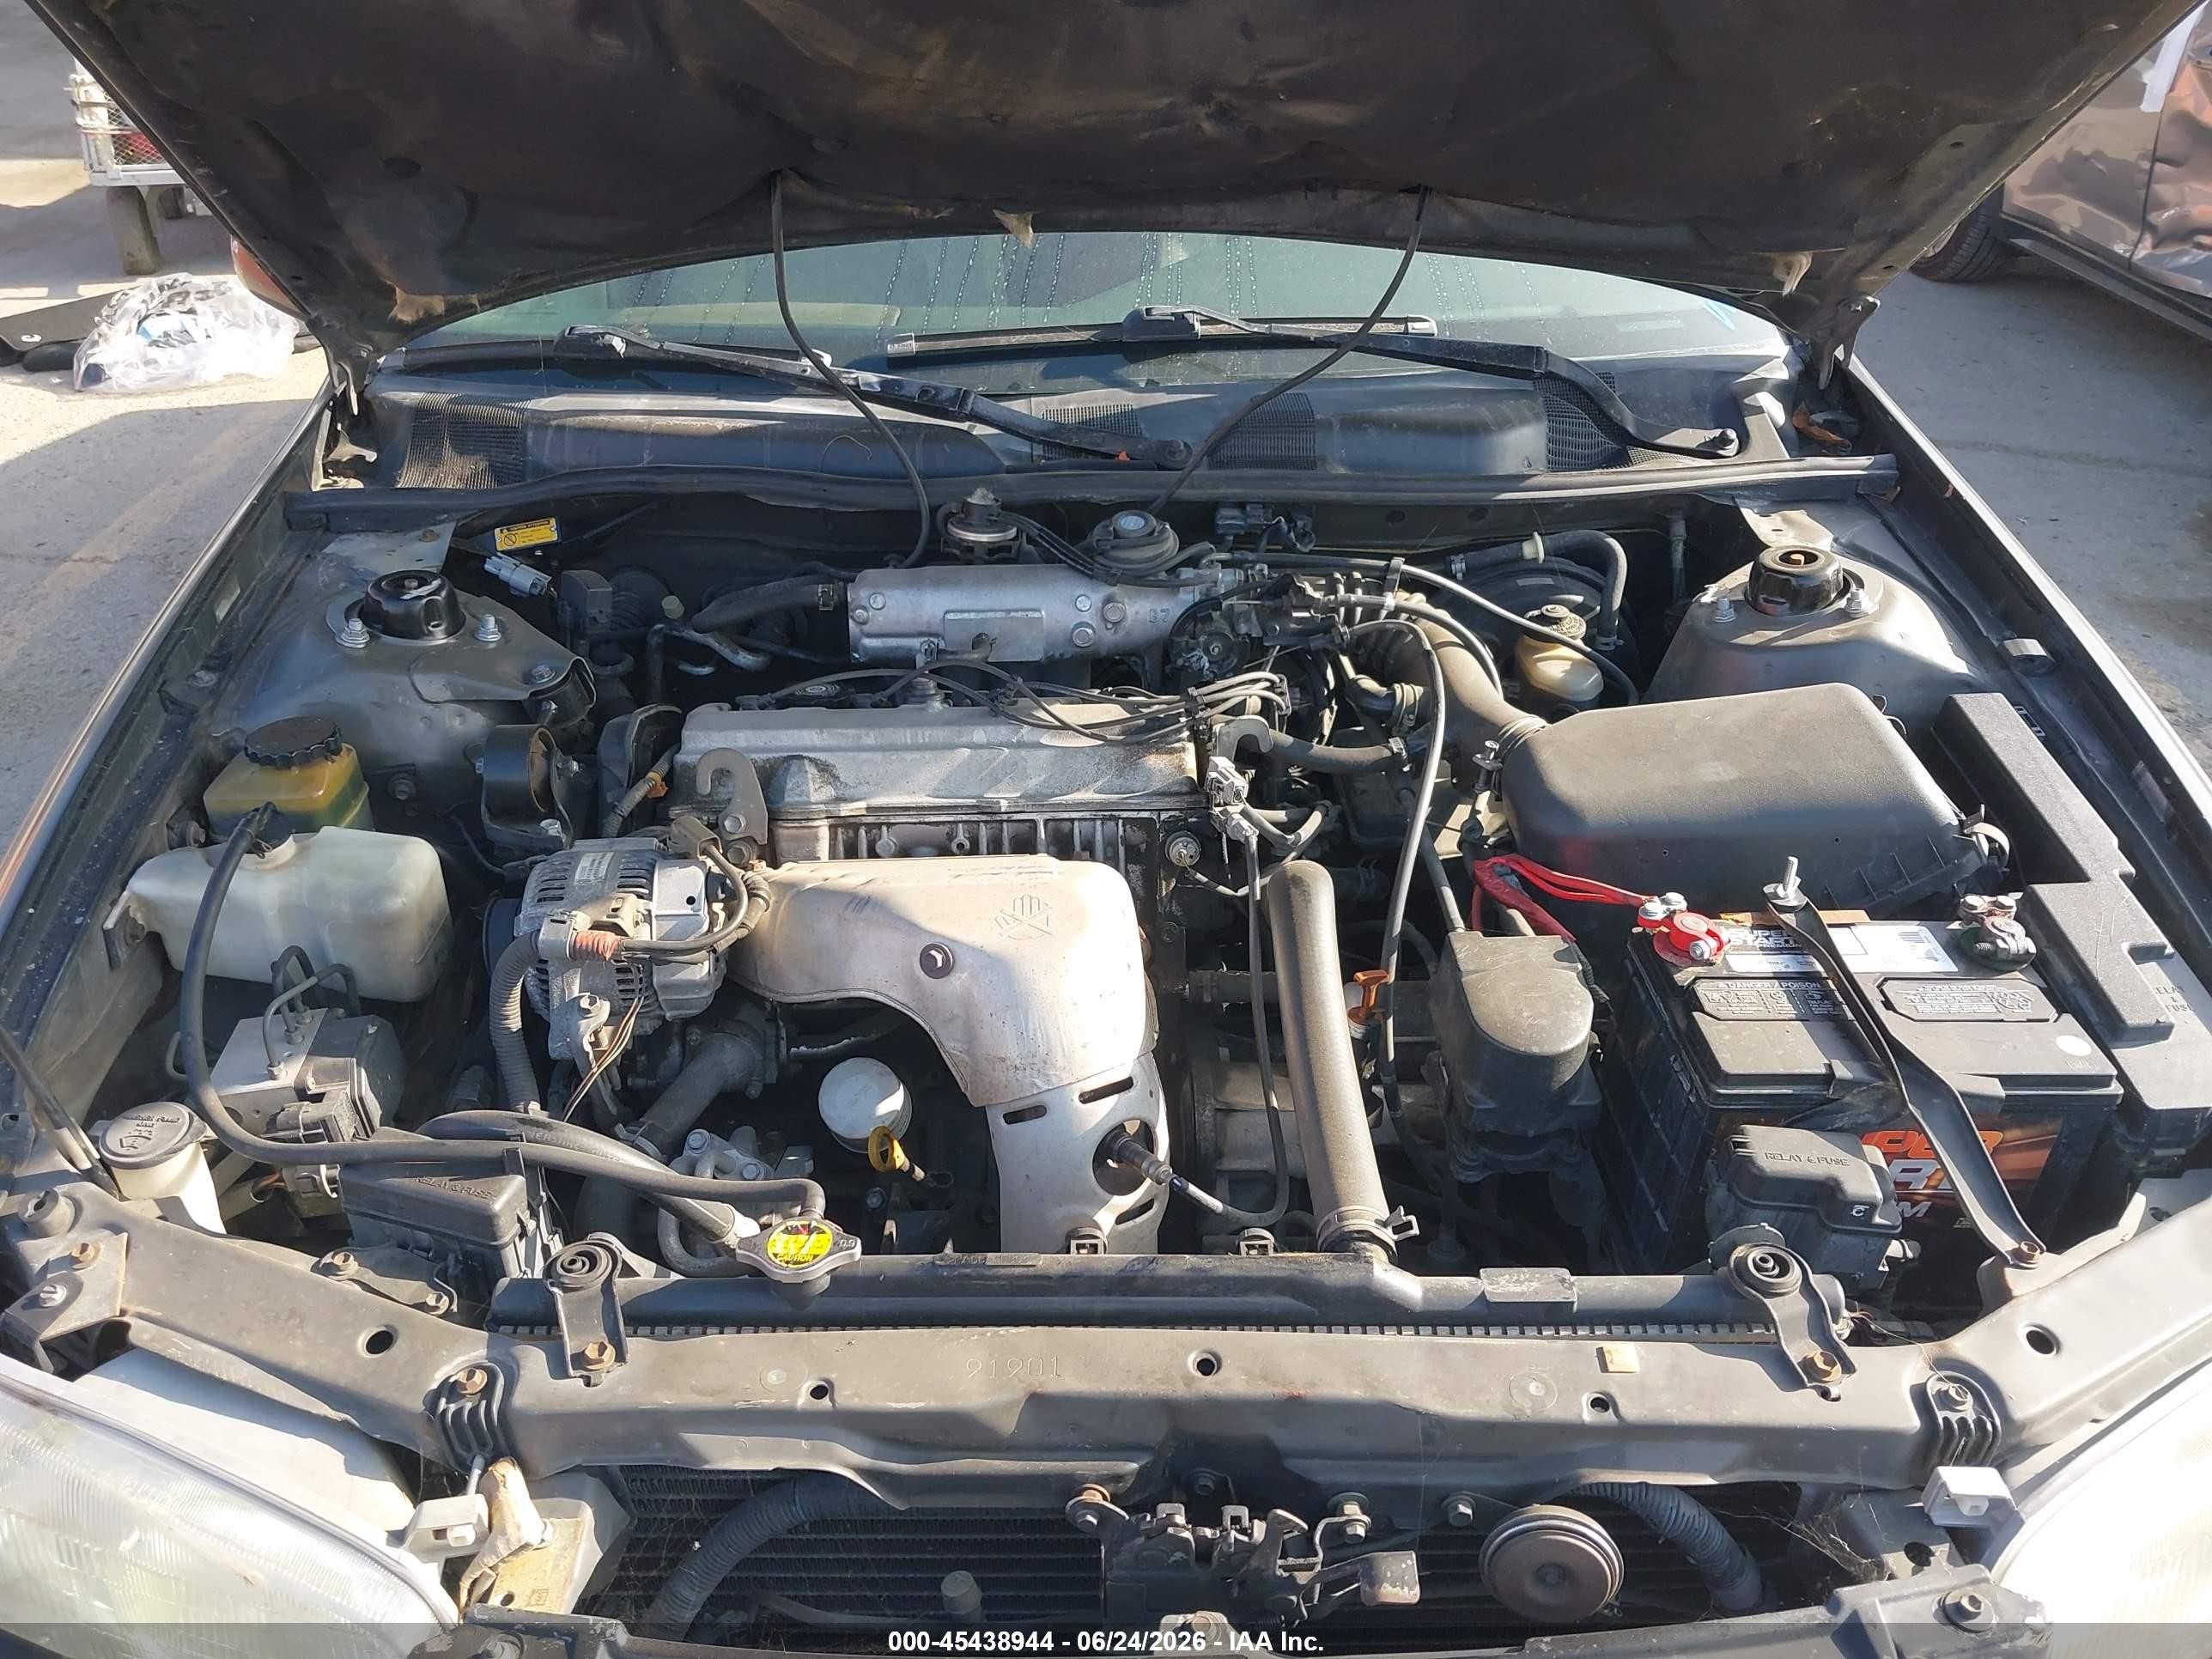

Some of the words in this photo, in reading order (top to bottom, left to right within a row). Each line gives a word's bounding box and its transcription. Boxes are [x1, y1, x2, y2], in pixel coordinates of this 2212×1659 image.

[1764, 1152, 1802, 1163] RELAY
[1817, 1158, 1850, 1167] FUSE
[776, 1253, 813, 1262] CAUTION
[966, 1356, 1062, 1380] 91901
